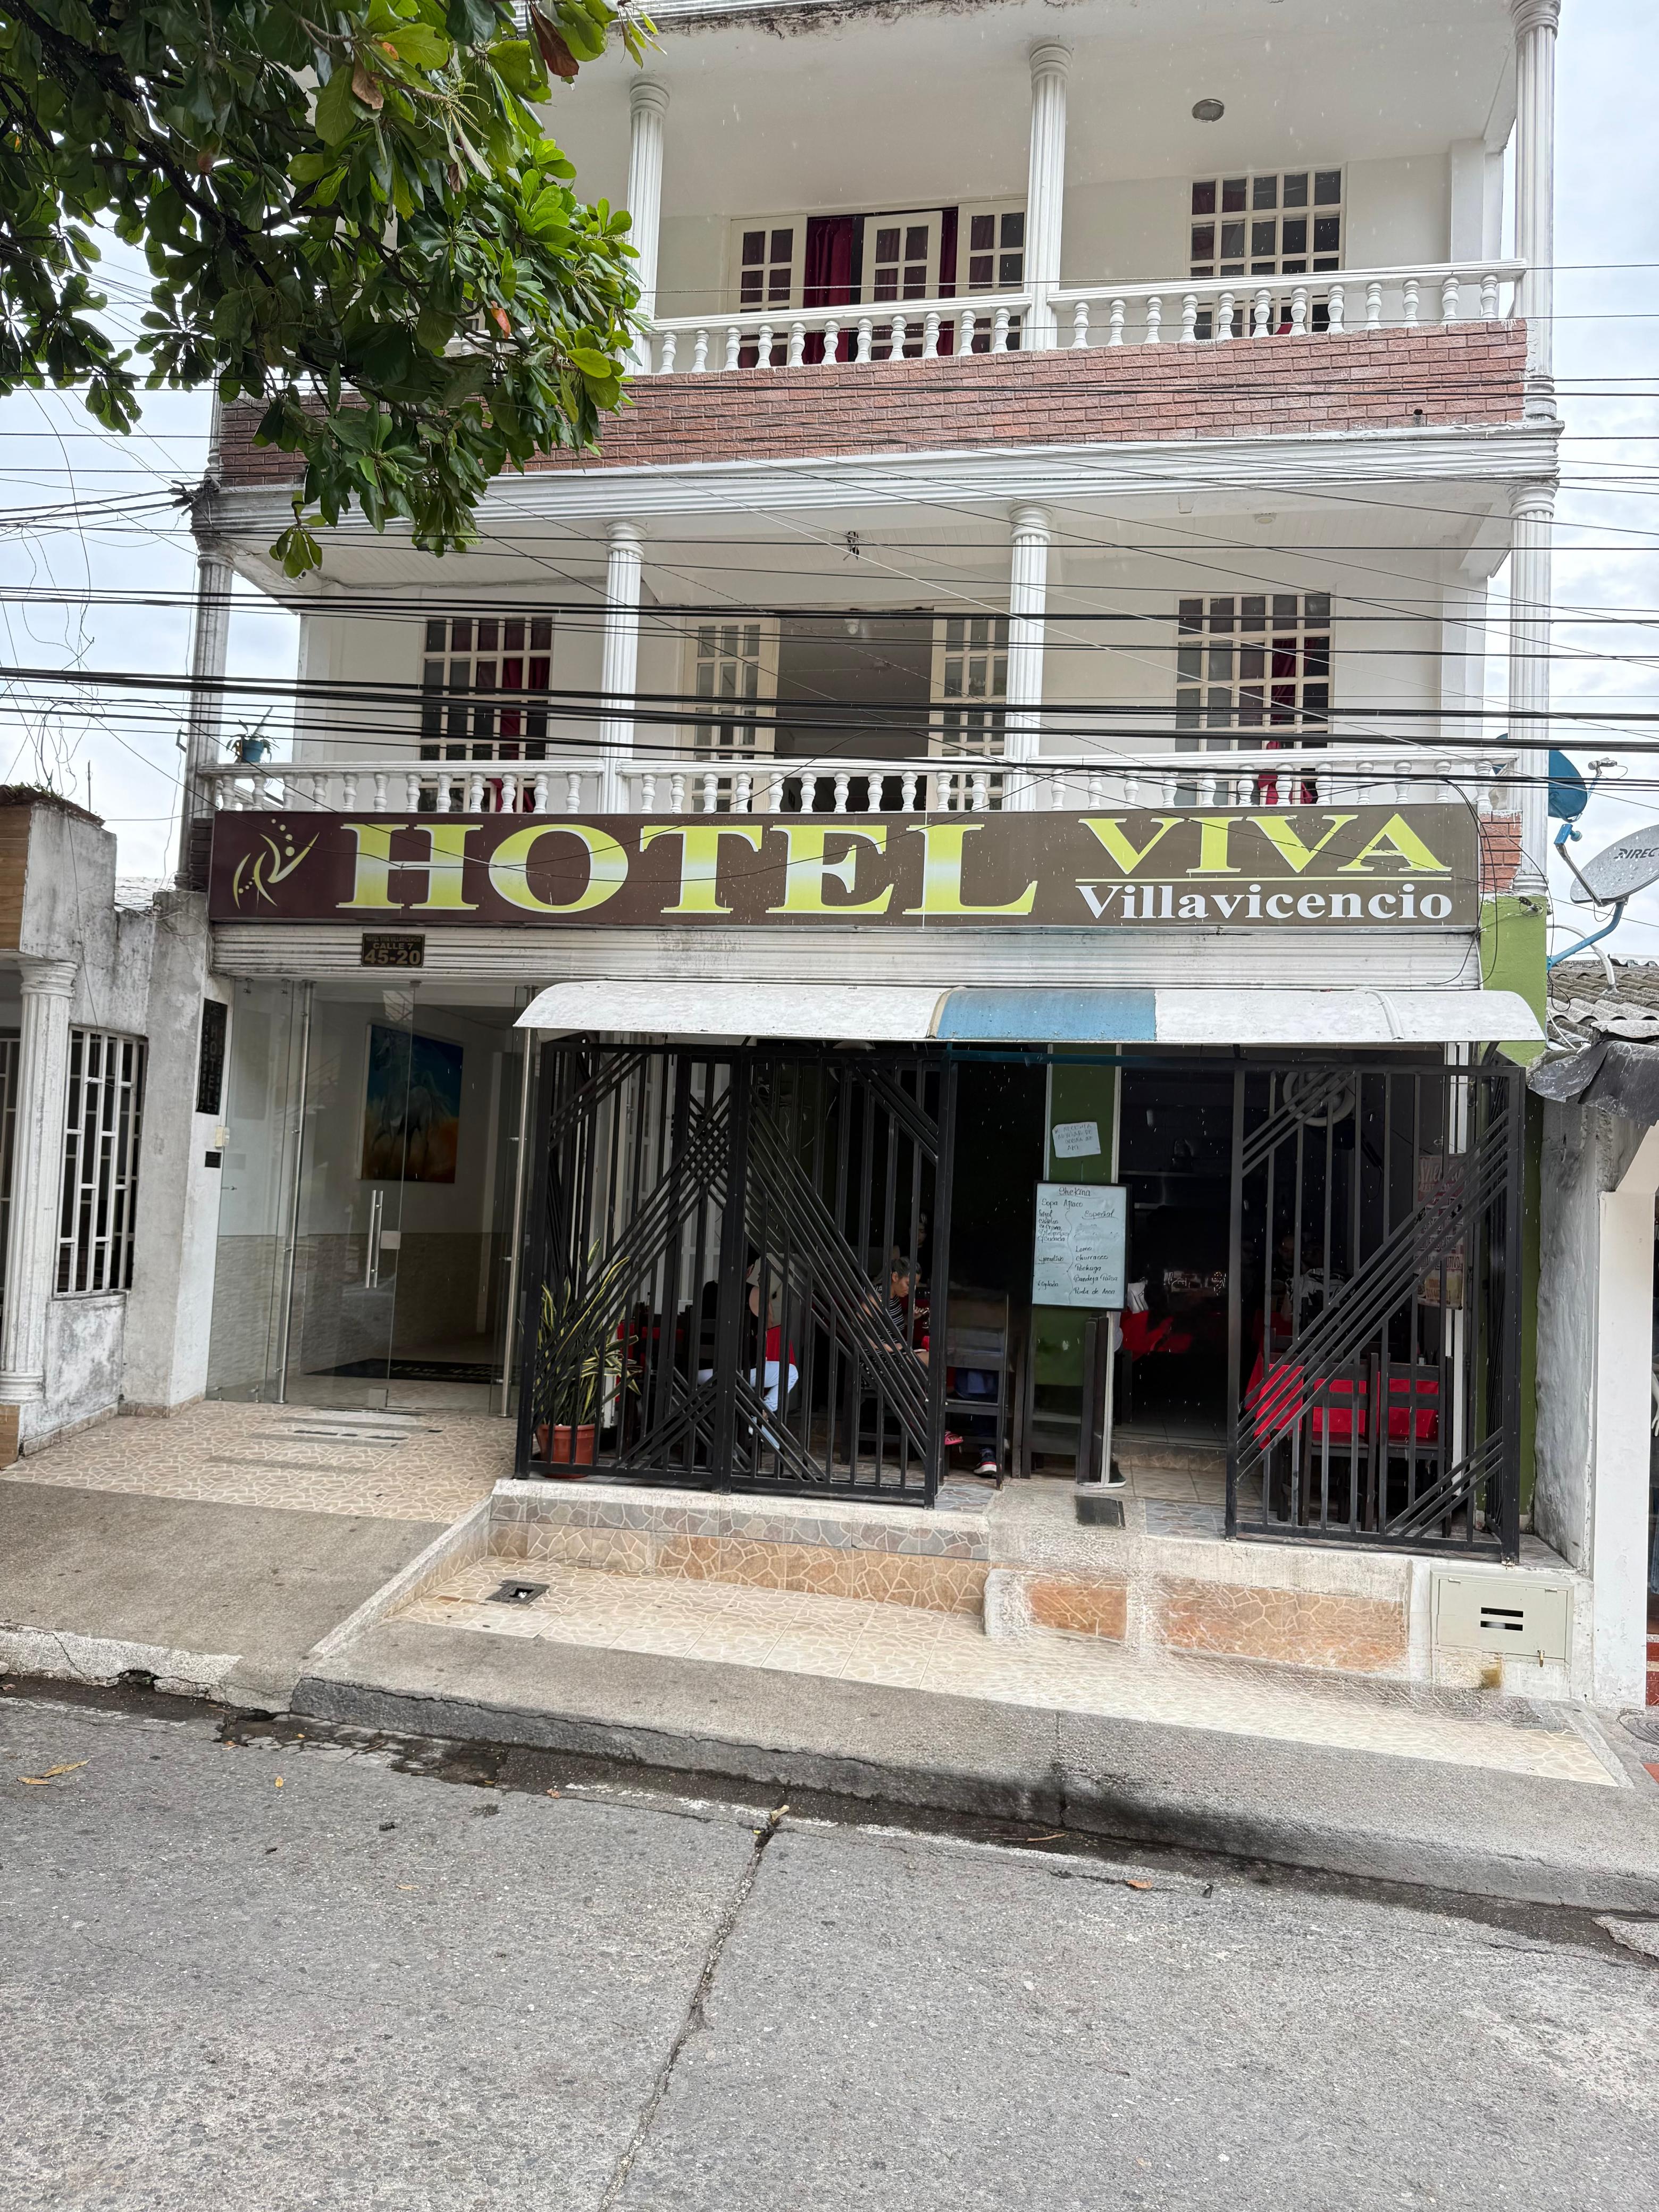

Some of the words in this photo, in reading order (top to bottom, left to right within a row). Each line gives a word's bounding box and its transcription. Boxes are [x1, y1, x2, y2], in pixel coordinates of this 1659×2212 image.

[1613, 848, 1659, 859] DIREC
[336, 823, 1038, 915] HOTEL
[1078, 814, 1452, 875] VIVA
[1076, 883, 1453, 919] Villavicencio
[364, 949, 421, 965] 45-20
[207, 1025, 217, 1105] HOTEL
[1042, 1198, 1058, 1209] Sopa
[1063, 1199, 1083, 1210] Ajiaco
[1084, 1209, 1115, 1219] Especial
[1075, 1264, 1101, 1273] Pechuga
[1074, 1275, 1098, 1285] Bandeja
